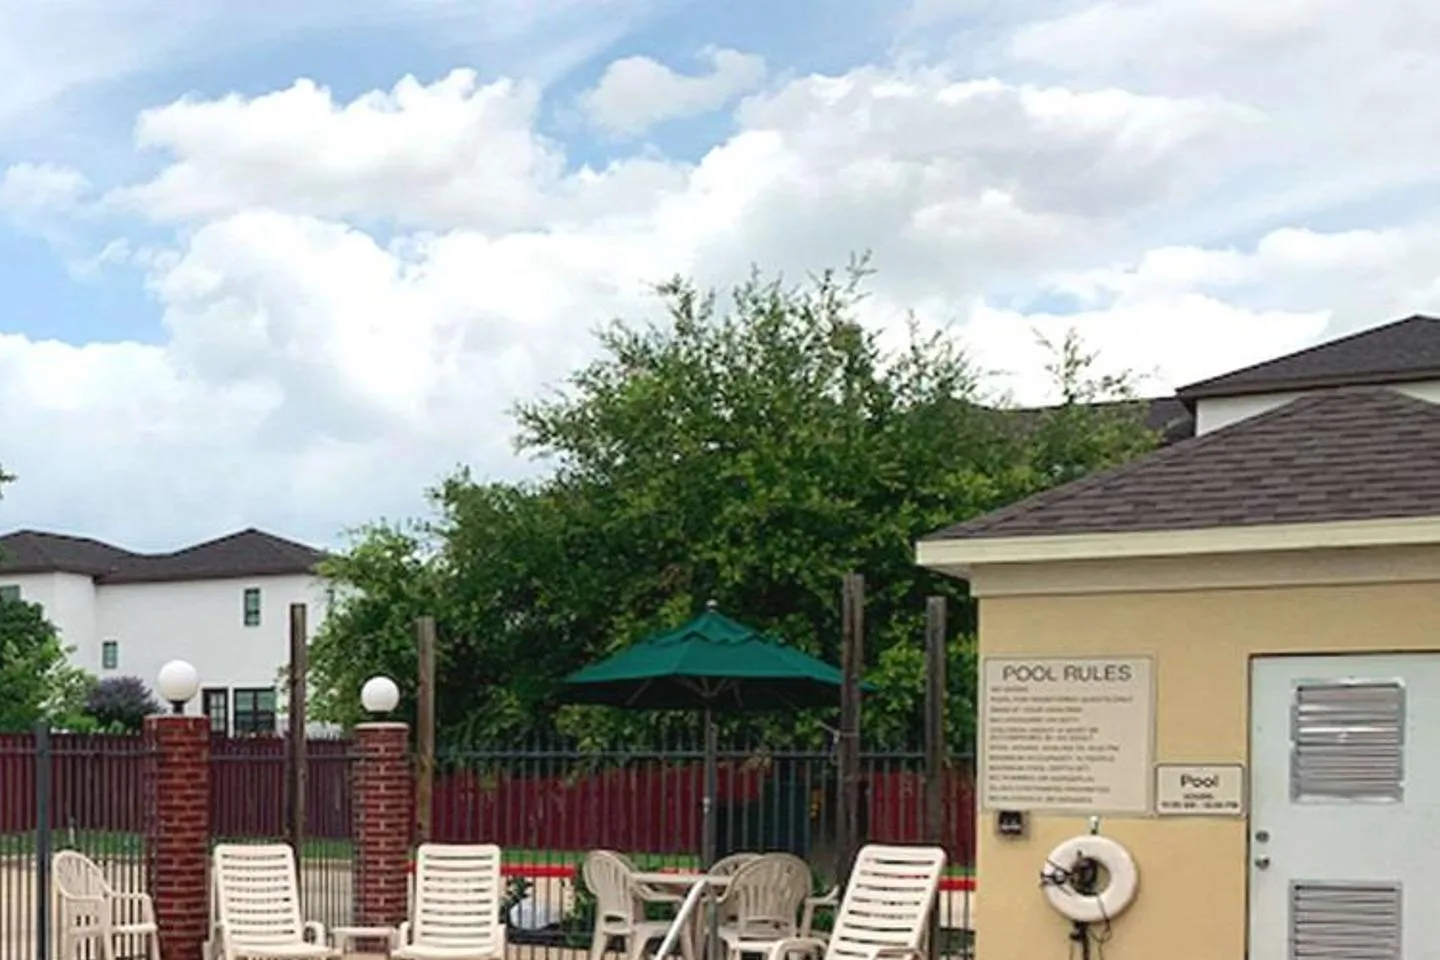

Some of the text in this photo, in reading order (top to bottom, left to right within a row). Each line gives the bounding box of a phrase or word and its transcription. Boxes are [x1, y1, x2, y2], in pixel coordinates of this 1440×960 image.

[1002, 663, 1133, 682] POOL RULES
[1180, 773, 1219, 789] Pool
